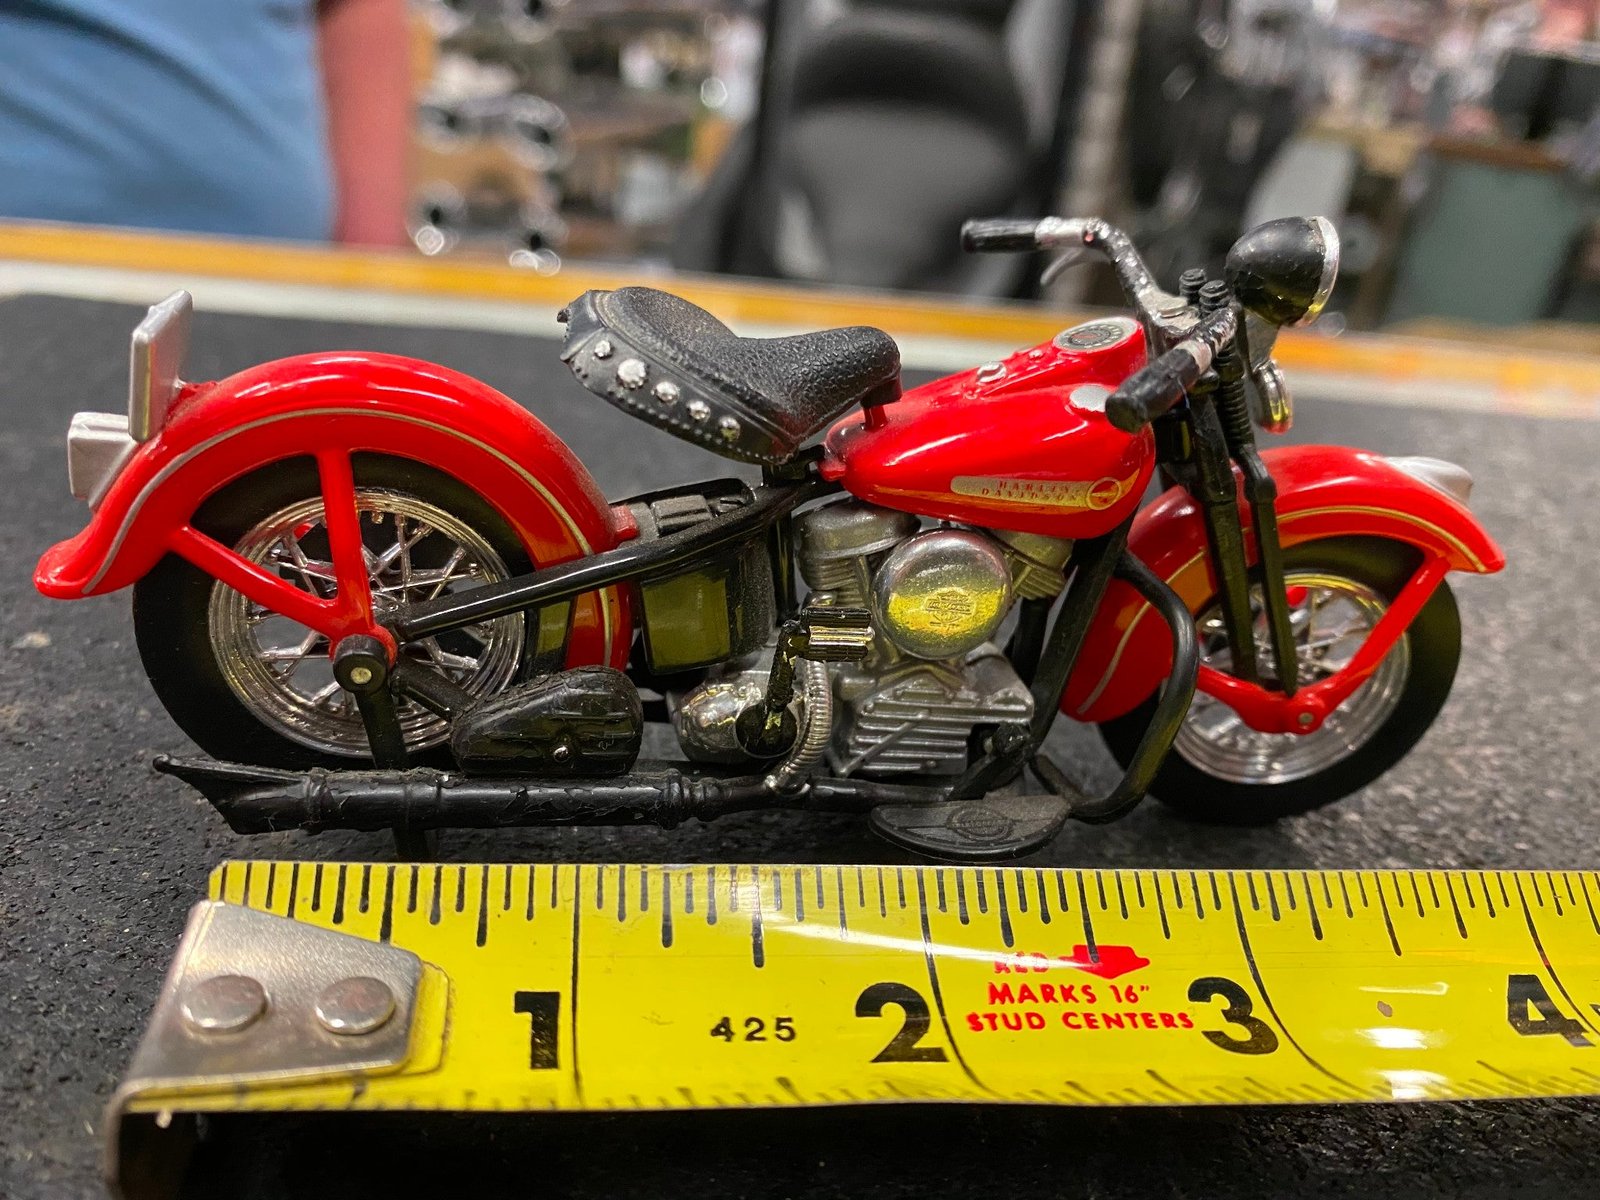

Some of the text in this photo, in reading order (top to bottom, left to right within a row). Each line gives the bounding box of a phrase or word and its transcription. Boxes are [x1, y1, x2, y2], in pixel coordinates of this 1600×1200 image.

[513, 990, 561, 1070] 1
[710, 1016, 797, 1042] 425
[855, 982, 950, 1063] 2
[965, 1011, 1195, 1032] STUD CENTERS
[988, 982, 1097, 1006] MARKS
[1186, 976, 1279, 1055] 3
[1506, 974, 1596, 1048] 4
